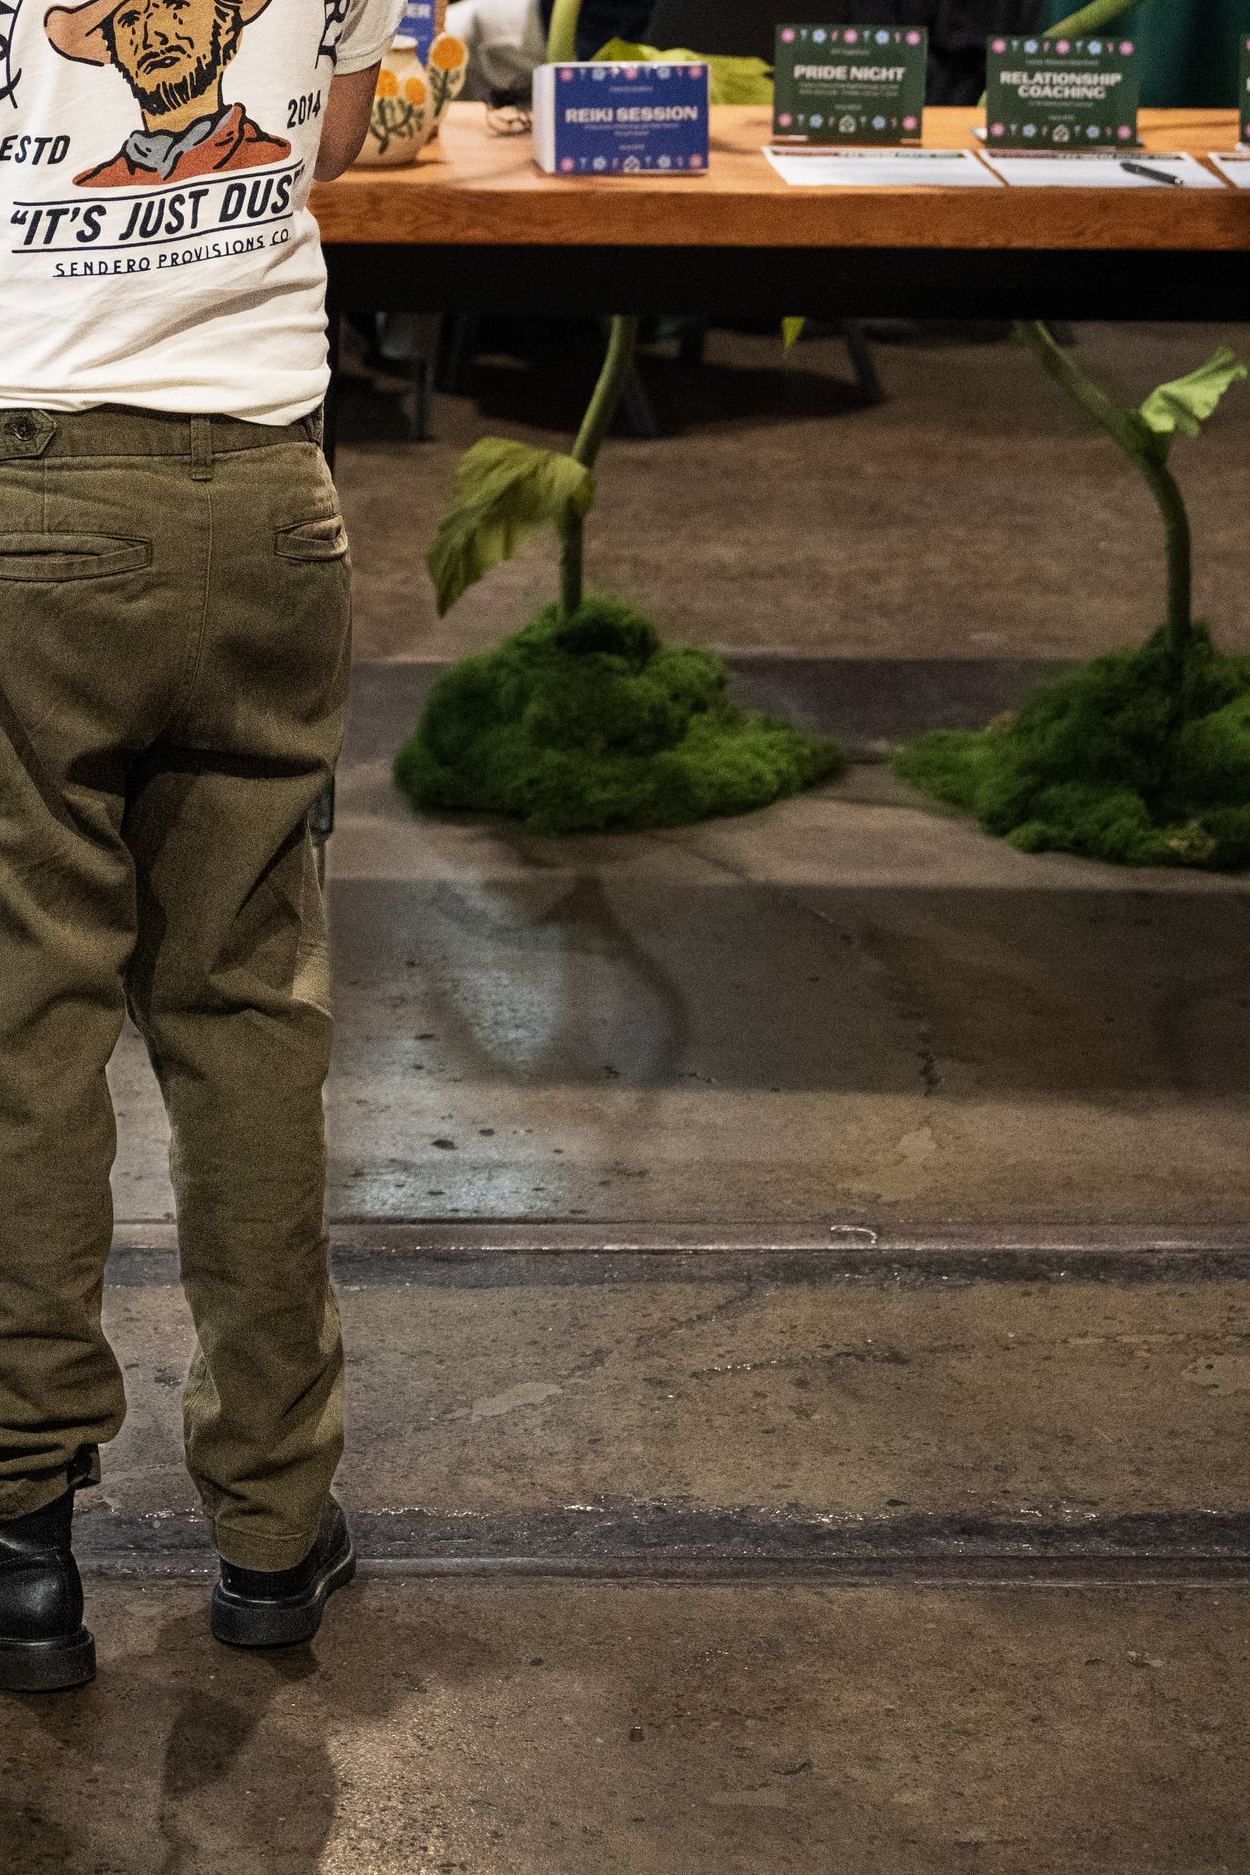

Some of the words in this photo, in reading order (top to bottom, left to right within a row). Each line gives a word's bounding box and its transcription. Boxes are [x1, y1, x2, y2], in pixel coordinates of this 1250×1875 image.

[793, 65, 848, 80] PRIDE
[850, 66, 906, 81] NIGHT
[1000, 72, 1122, 86] RELATIONSHIP
[1018, 85, 1106, 99] COACHING
[287, 90, 321, 129] 2014
[565, 107, 613, 123] REIKI
[616, 105, 699, 122] SESSION
[119, 189, 210, 240] JUST
[54, 257, 151, 277] SENDERO
[157, 235, 265, 268] PROVISIONS
